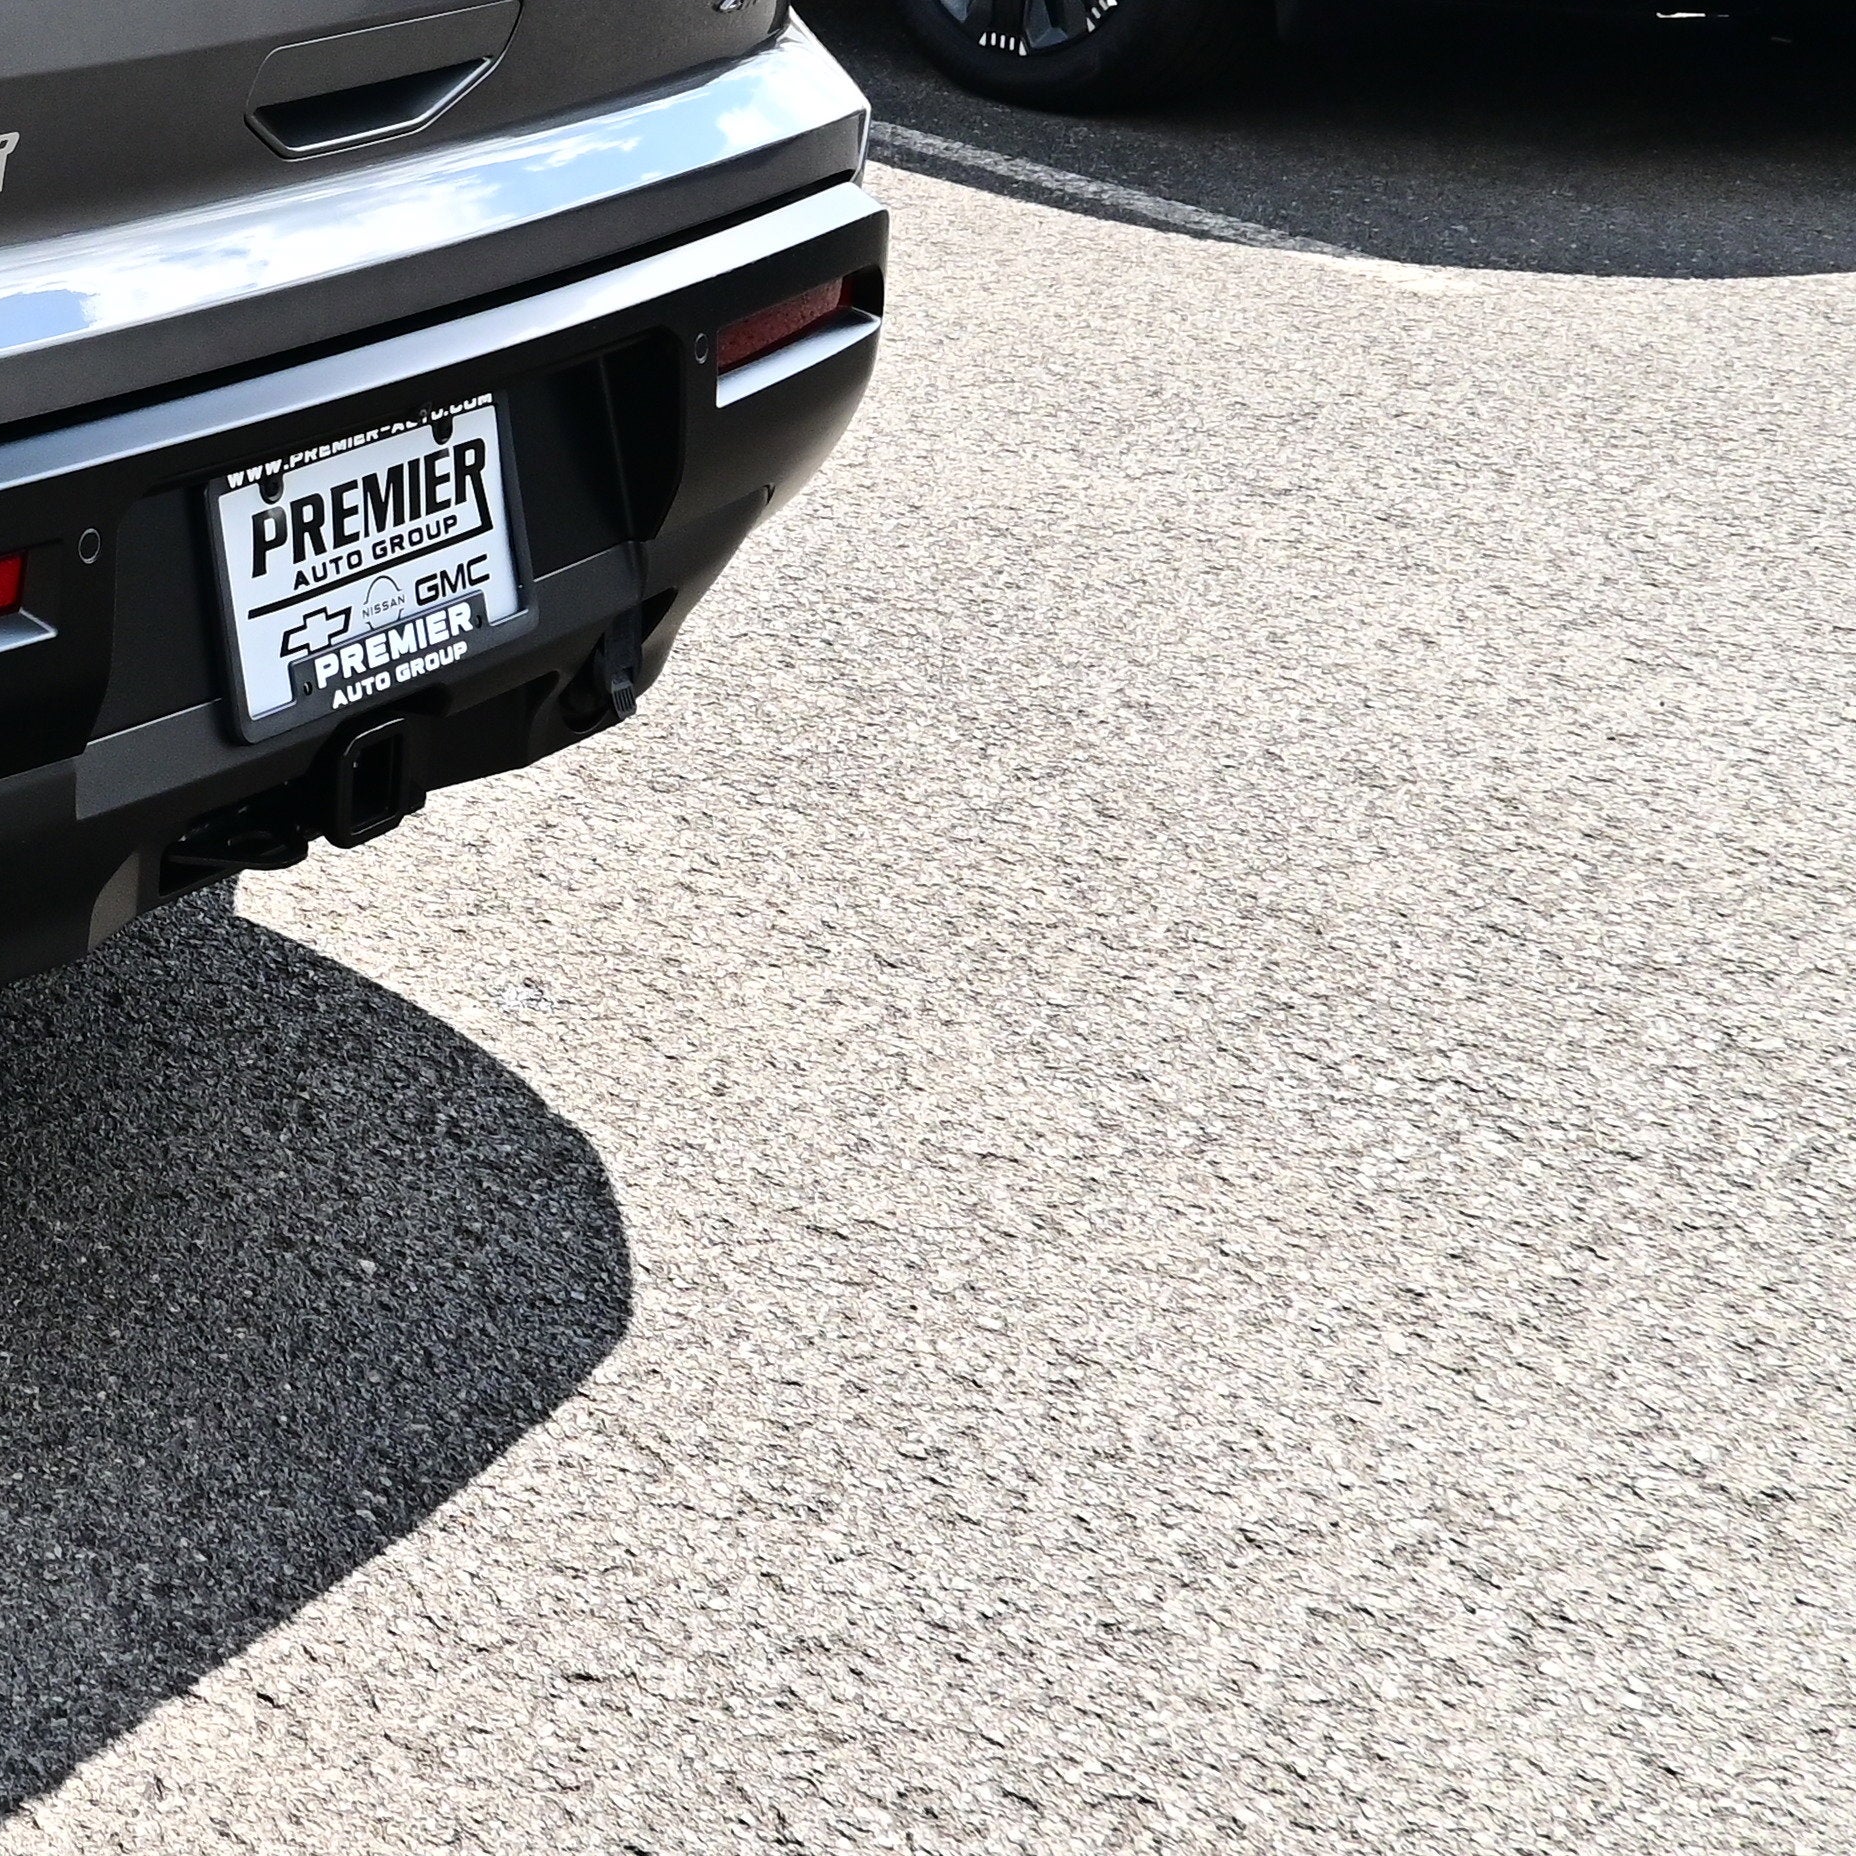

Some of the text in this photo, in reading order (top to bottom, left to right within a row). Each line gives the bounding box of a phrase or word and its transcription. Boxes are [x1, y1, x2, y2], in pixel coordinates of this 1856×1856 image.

[251, 437, 494, 579] PREMIER
[293, 514, 458, 590] AUTO GROUP
[414, 554, 491, 606] GMC
[361, 594, 406, 618] NISSAN
[314, 601, 474, 690] PREMIER
[332, 640, 468, 710] AUTO GROUP
